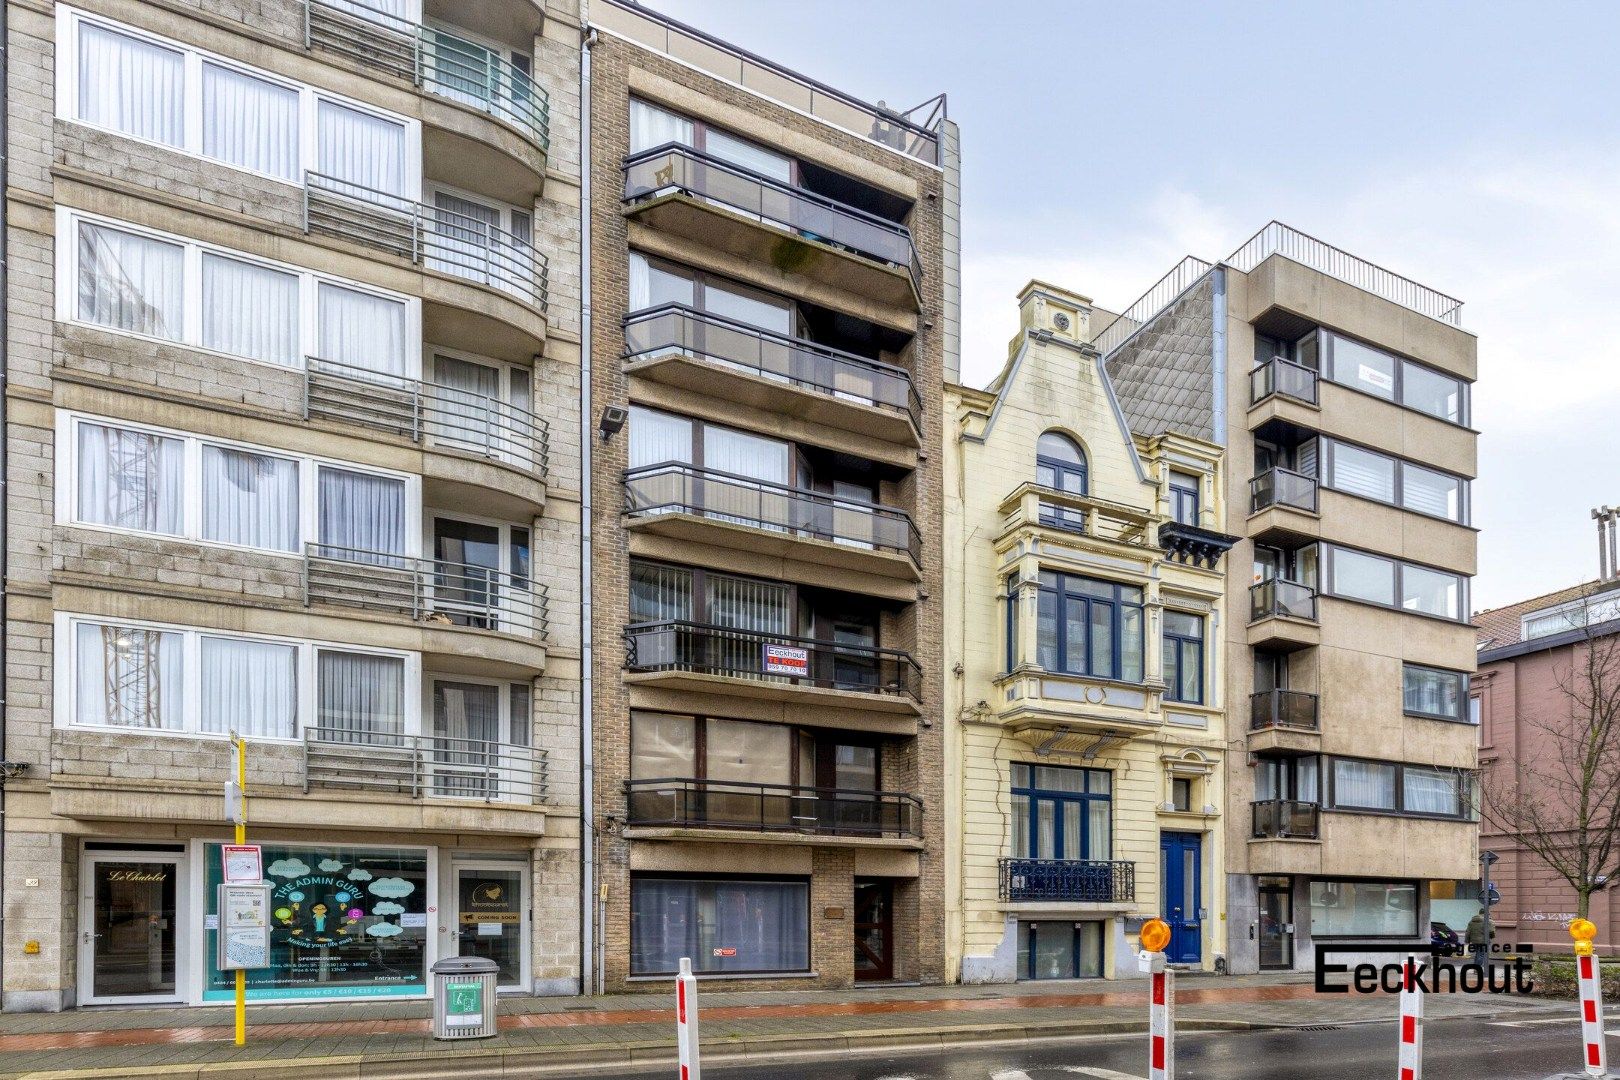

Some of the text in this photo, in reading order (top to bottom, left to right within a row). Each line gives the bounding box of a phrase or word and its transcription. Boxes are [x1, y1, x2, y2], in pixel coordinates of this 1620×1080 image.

[768, 646, 805, 659] Eeckhout
[768, 657, 805, 667] TE KOOP
[274, 882, 296, 900] THE
[295, 876, 334, 888] ADMIN
[336, 879, 364, 900] GURU
[287, 937, 311, 949] Making
[338, 936, 353, 946] easy
